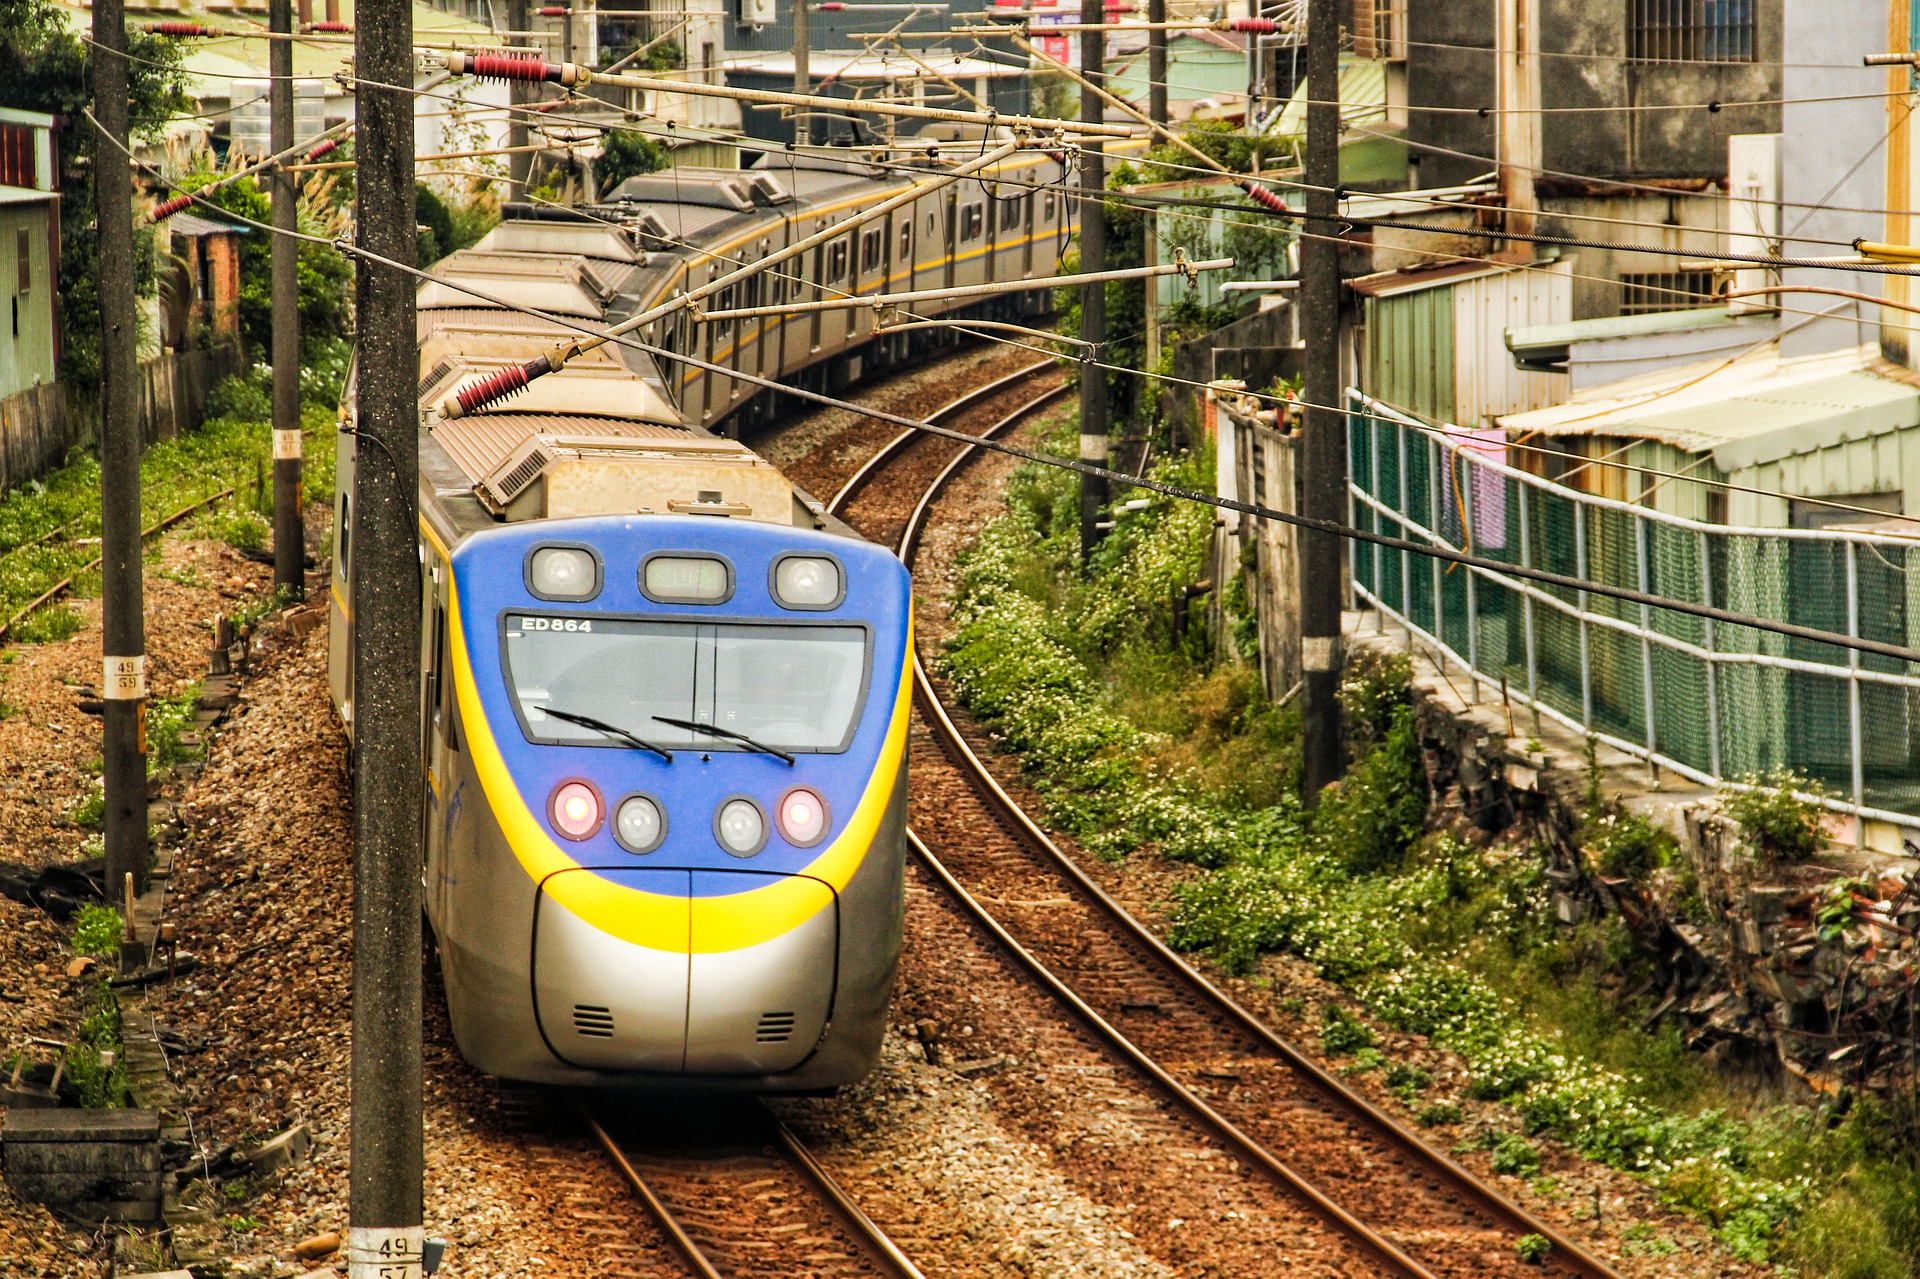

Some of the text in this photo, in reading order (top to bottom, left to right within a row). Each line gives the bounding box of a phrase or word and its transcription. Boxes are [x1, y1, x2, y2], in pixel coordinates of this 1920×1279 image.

[521, 617, 592, 633] ED864
[118, 661, 134, 673] 49
[119, 677, 136, 688] 59
[379, 1238, 408, 1258] 49
